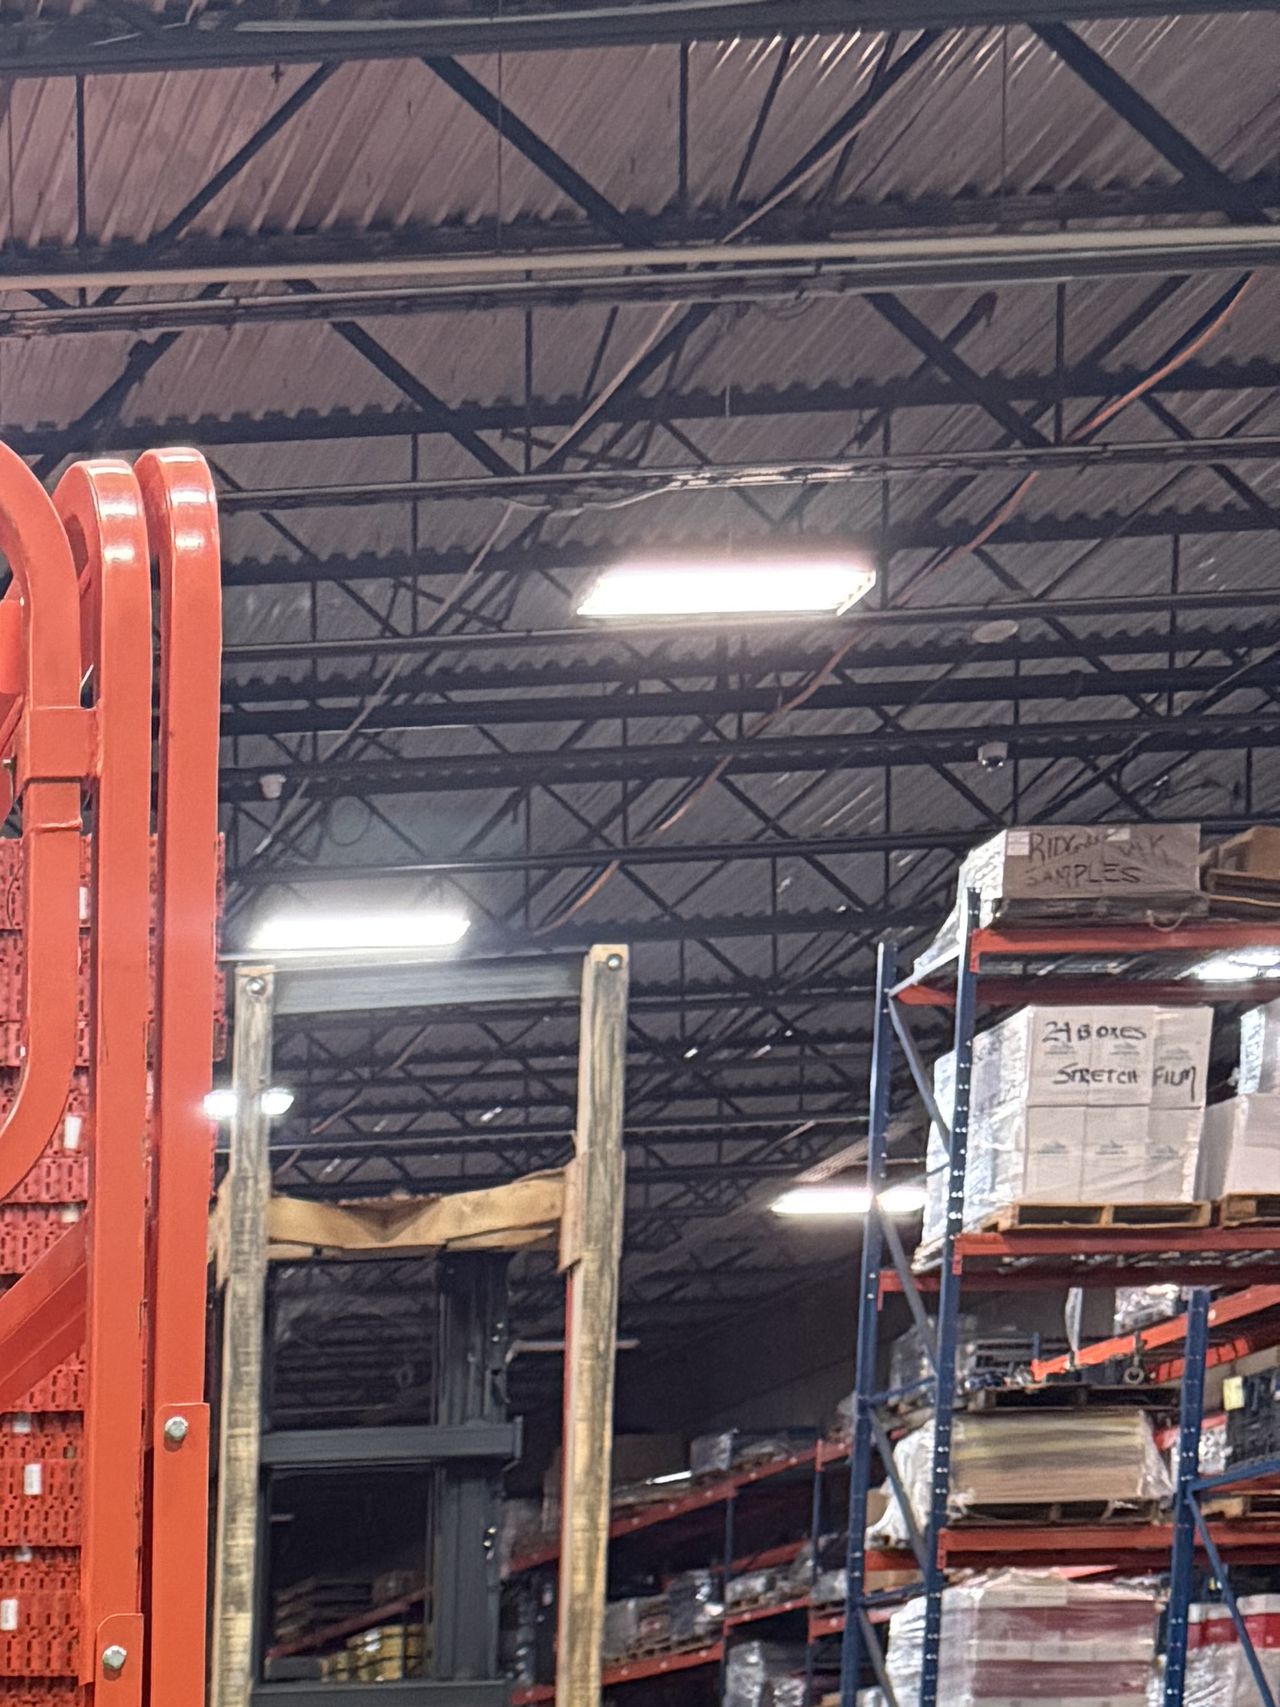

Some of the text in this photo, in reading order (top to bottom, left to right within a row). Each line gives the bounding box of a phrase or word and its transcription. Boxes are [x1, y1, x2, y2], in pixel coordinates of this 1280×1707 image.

[1025, 861, 1142, 888] SAMPLES
[1052, 1062, 1197, 1102] STRETCH FILM
